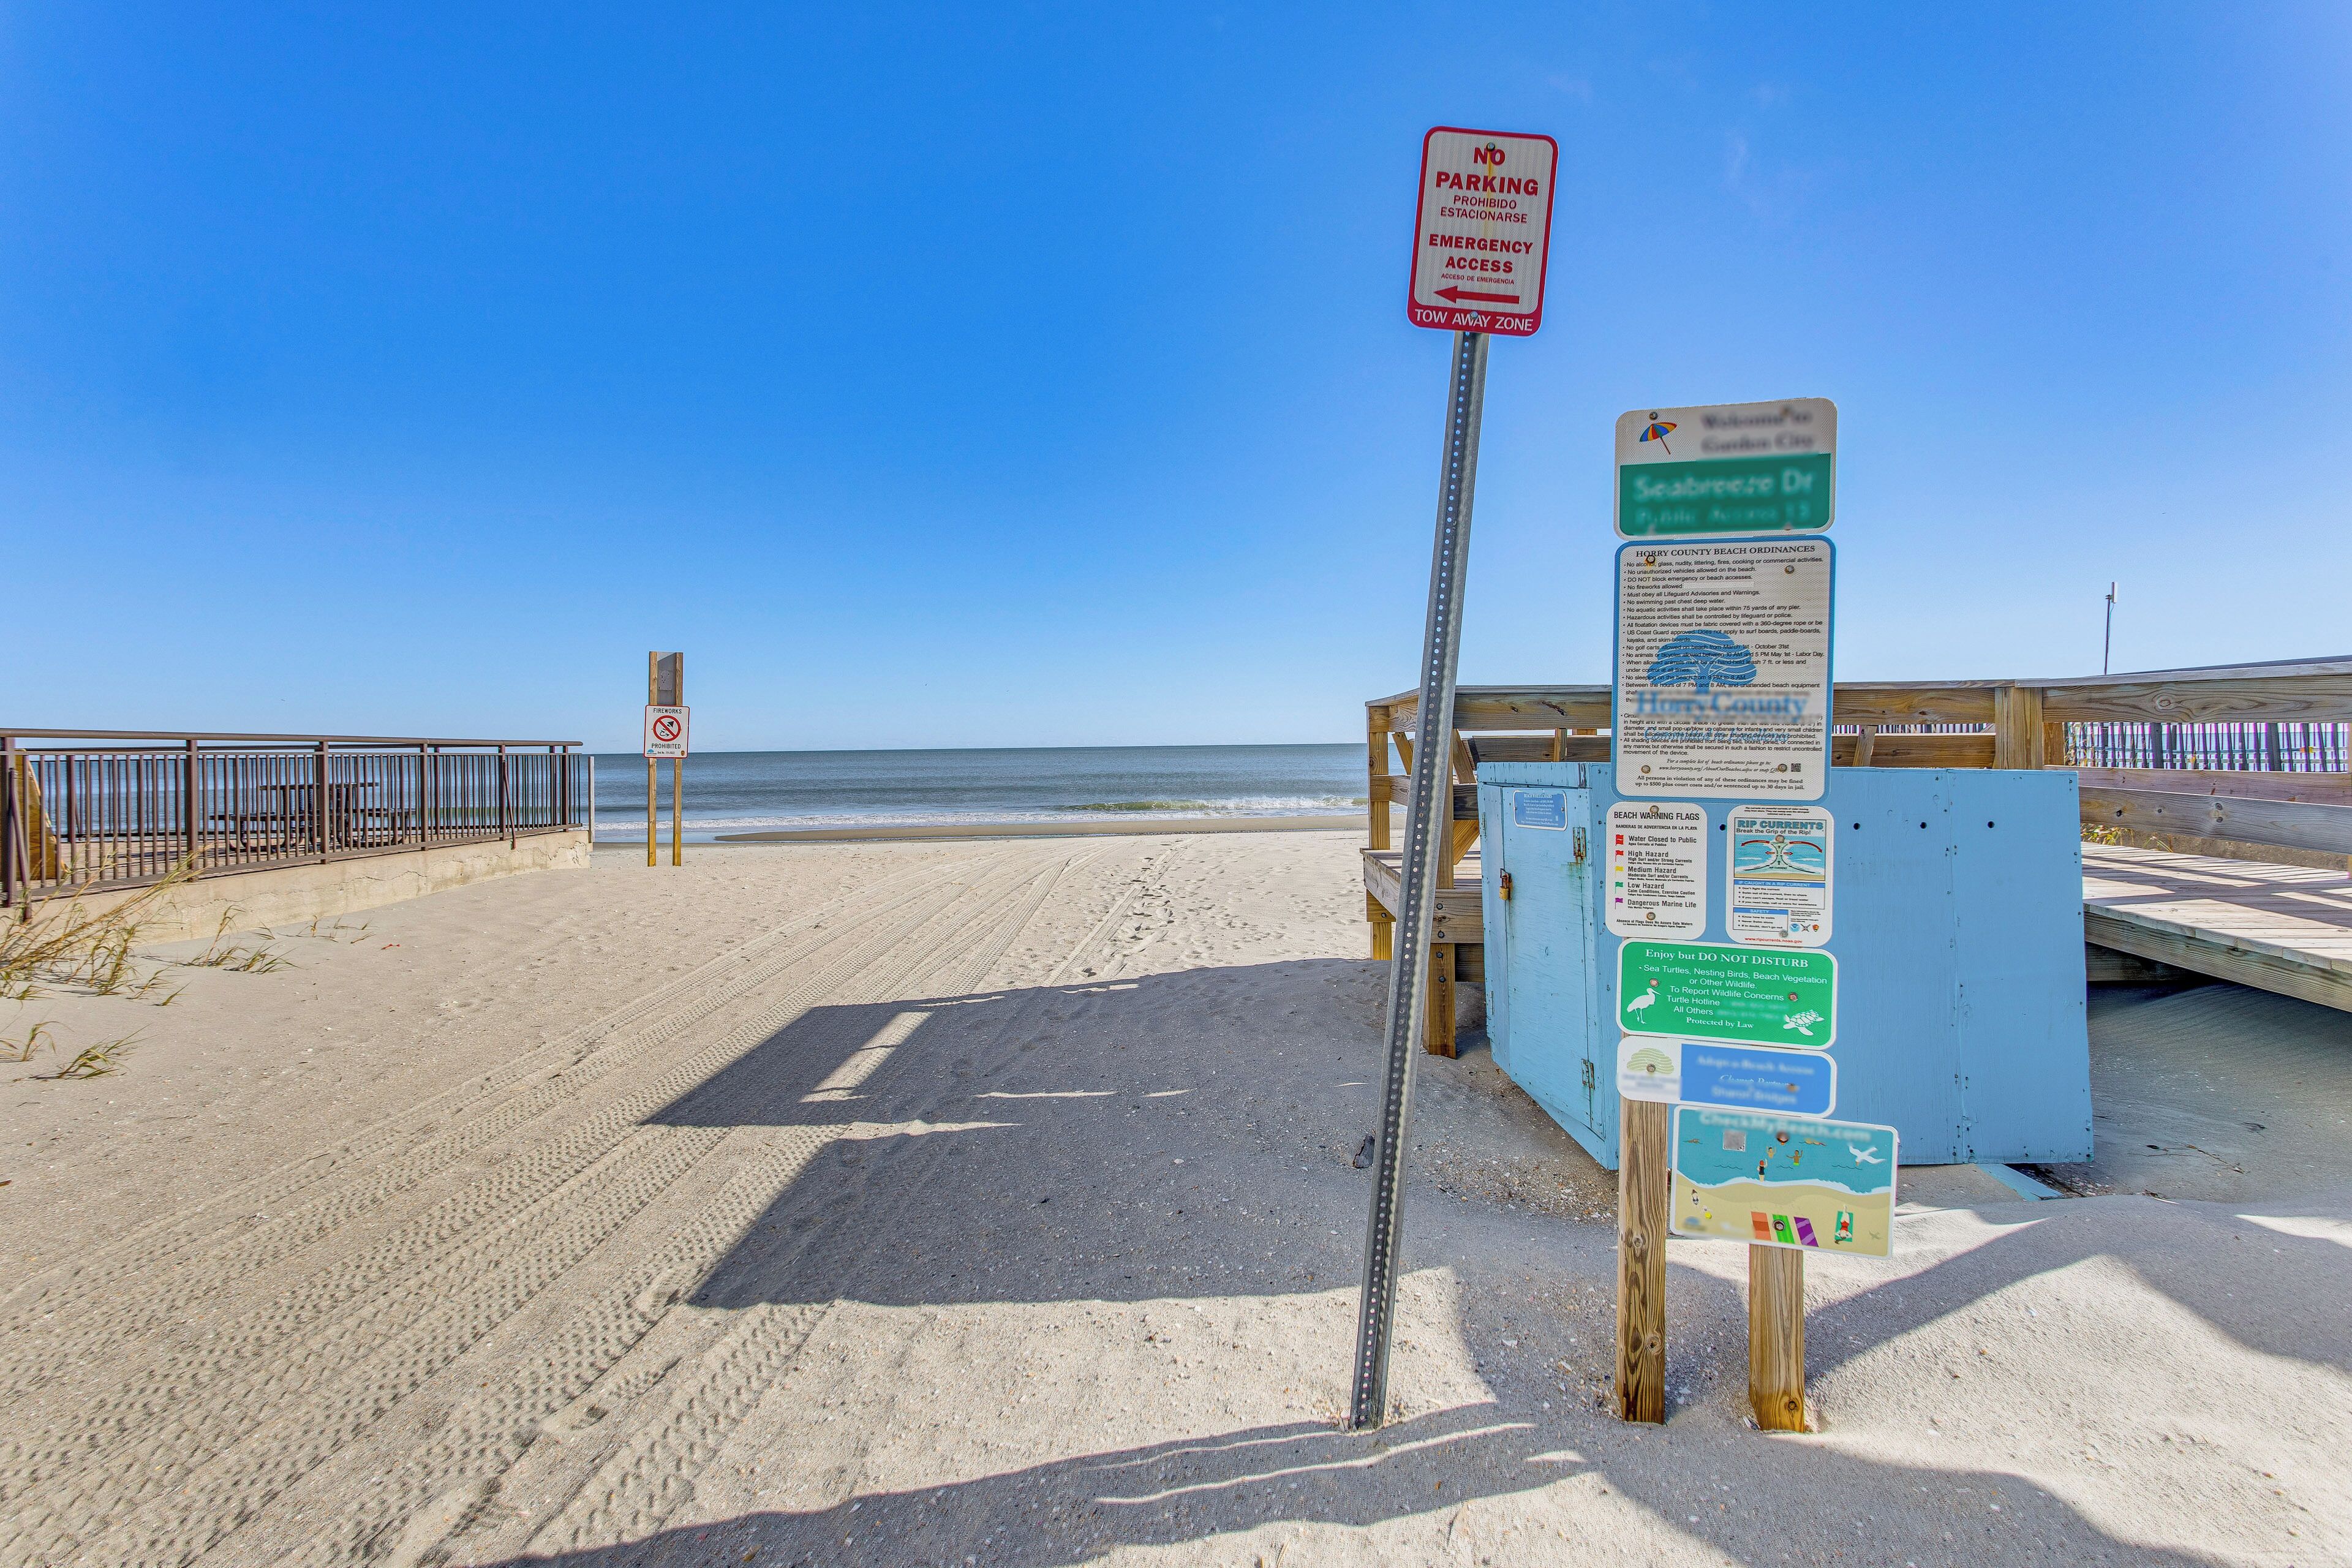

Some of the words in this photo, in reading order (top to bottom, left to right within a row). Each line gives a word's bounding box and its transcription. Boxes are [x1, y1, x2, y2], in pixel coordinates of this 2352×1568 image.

[1474, 147, 1506, 165] NO
[1436, 172, 1539, 196] PARKING
[1453, 195, 1517, 209] PROHIBIDO
[1440, 206, 1528, 223] ESTACIONARSE
[1429, 234, 1533, 254] EMERGENCY
[1446, 256, 1513, 273] ACCESS
[1477, 276, 1514, 285] EMERGENCIA
[1415, 309, 1447, 323] TOW
[1452, 313, 1490, 328] AWAY
[1494, 317, 1533, 331] ZONE
[1760, 821, 1823, 829] CURRENTS
[1646, 949, 1675, 960] Enjoy
[1721, 954, 1749, 963] NOT
[1752, 956, 1808, 967] DISTURB
[1663, 966, 1691, 975] Turtles,
[1694, 968, 1725, 978] Nesting
[1728, 971, 1750, 979] Birds,
[1754, 972, 1779, 981] Beach
[1782, 974, 1827, 984] Vegetation
[1725, 980, 1757, 989] Wildlife.
[1683, 987, 1709, 996] Report
[1712, 989, 1741, 997] Wildlife
[1744, 991, 1784, 1000] Concerns
[1686, 1006, 1713, 1015] Others
[1686, 1017, 1723, 1026] Protected
[1725, 1020, 1735, 1028] by
